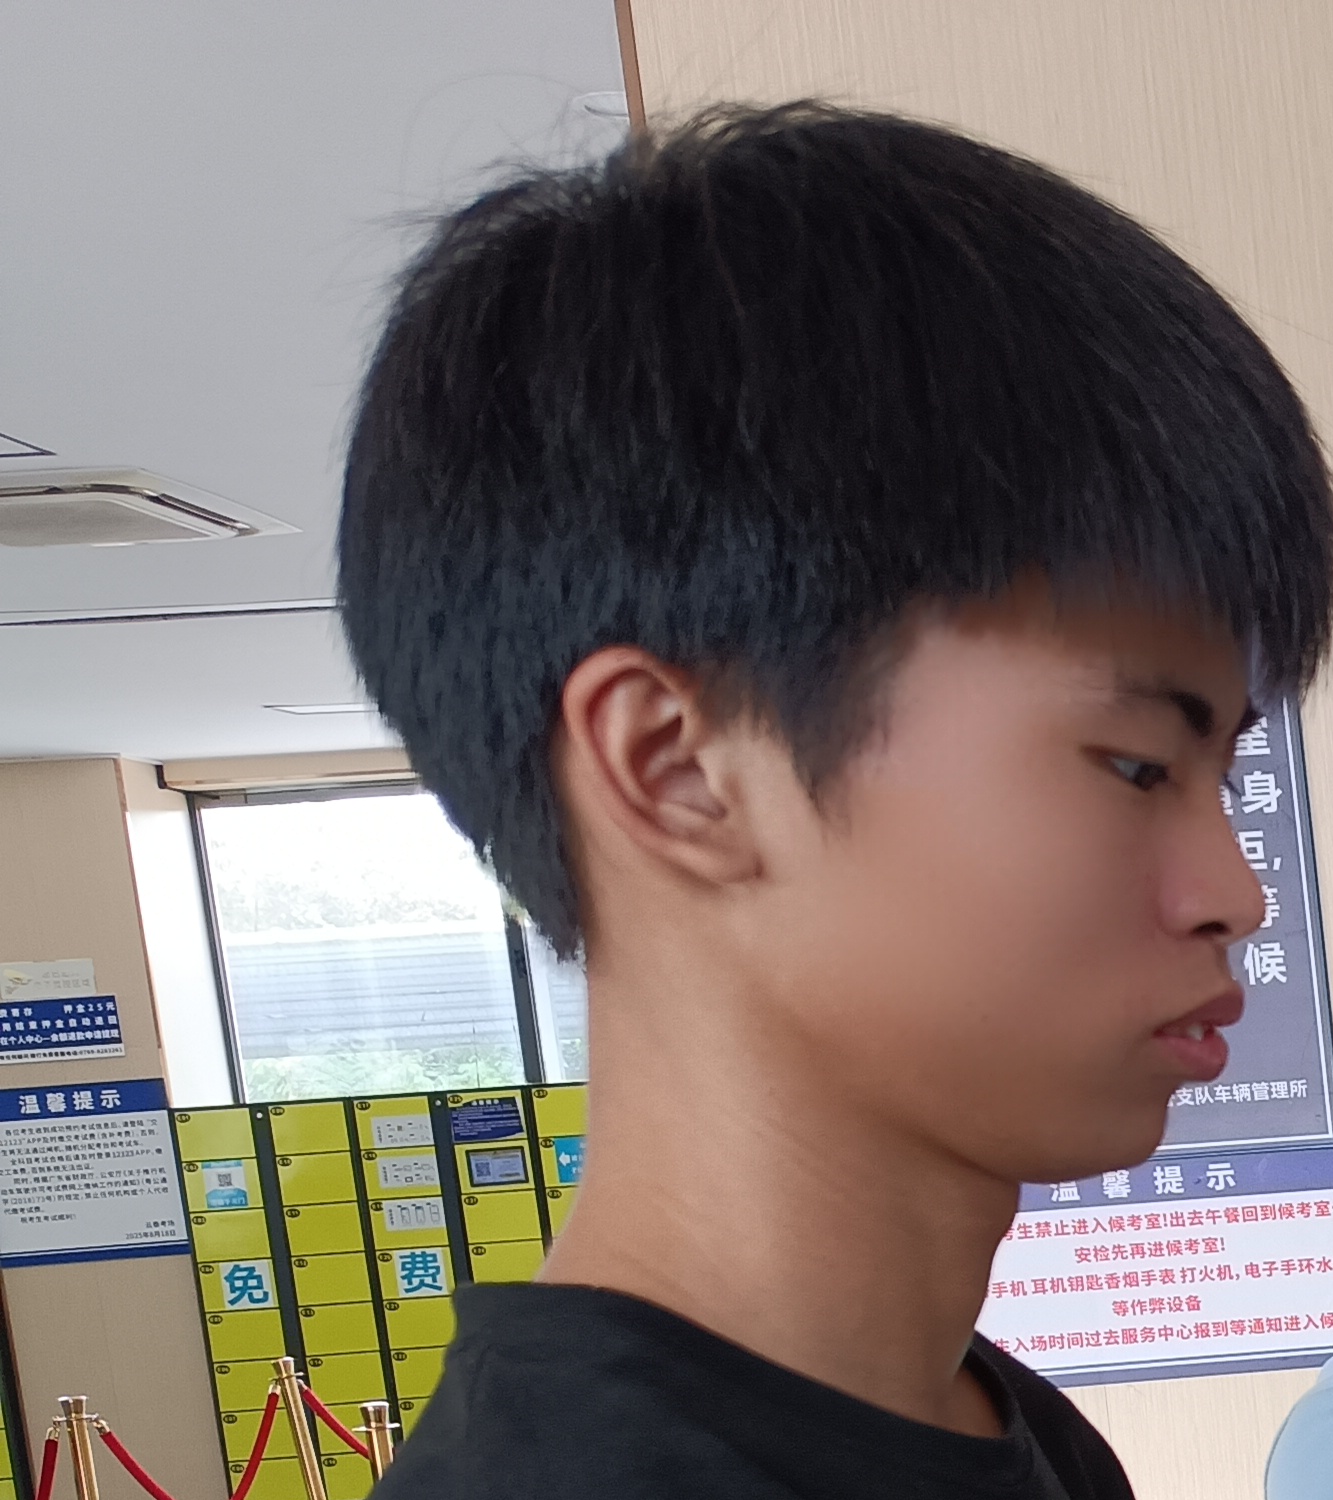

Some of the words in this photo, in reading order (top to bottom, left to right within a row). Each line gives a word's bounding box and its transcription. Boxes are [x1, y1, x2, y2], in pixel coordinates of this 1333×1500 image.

[1244, 942, 1289, 986] 候
[18, 1089, 122, 1115] 温馨提示
[1050, 1161, 1238, 1203] 温馨提示
[223, 1263, 270, 1307] 免
[399, 1251, 445, 1294] 费
[1112, 1295, 1202, 1318] 等作弊设备
